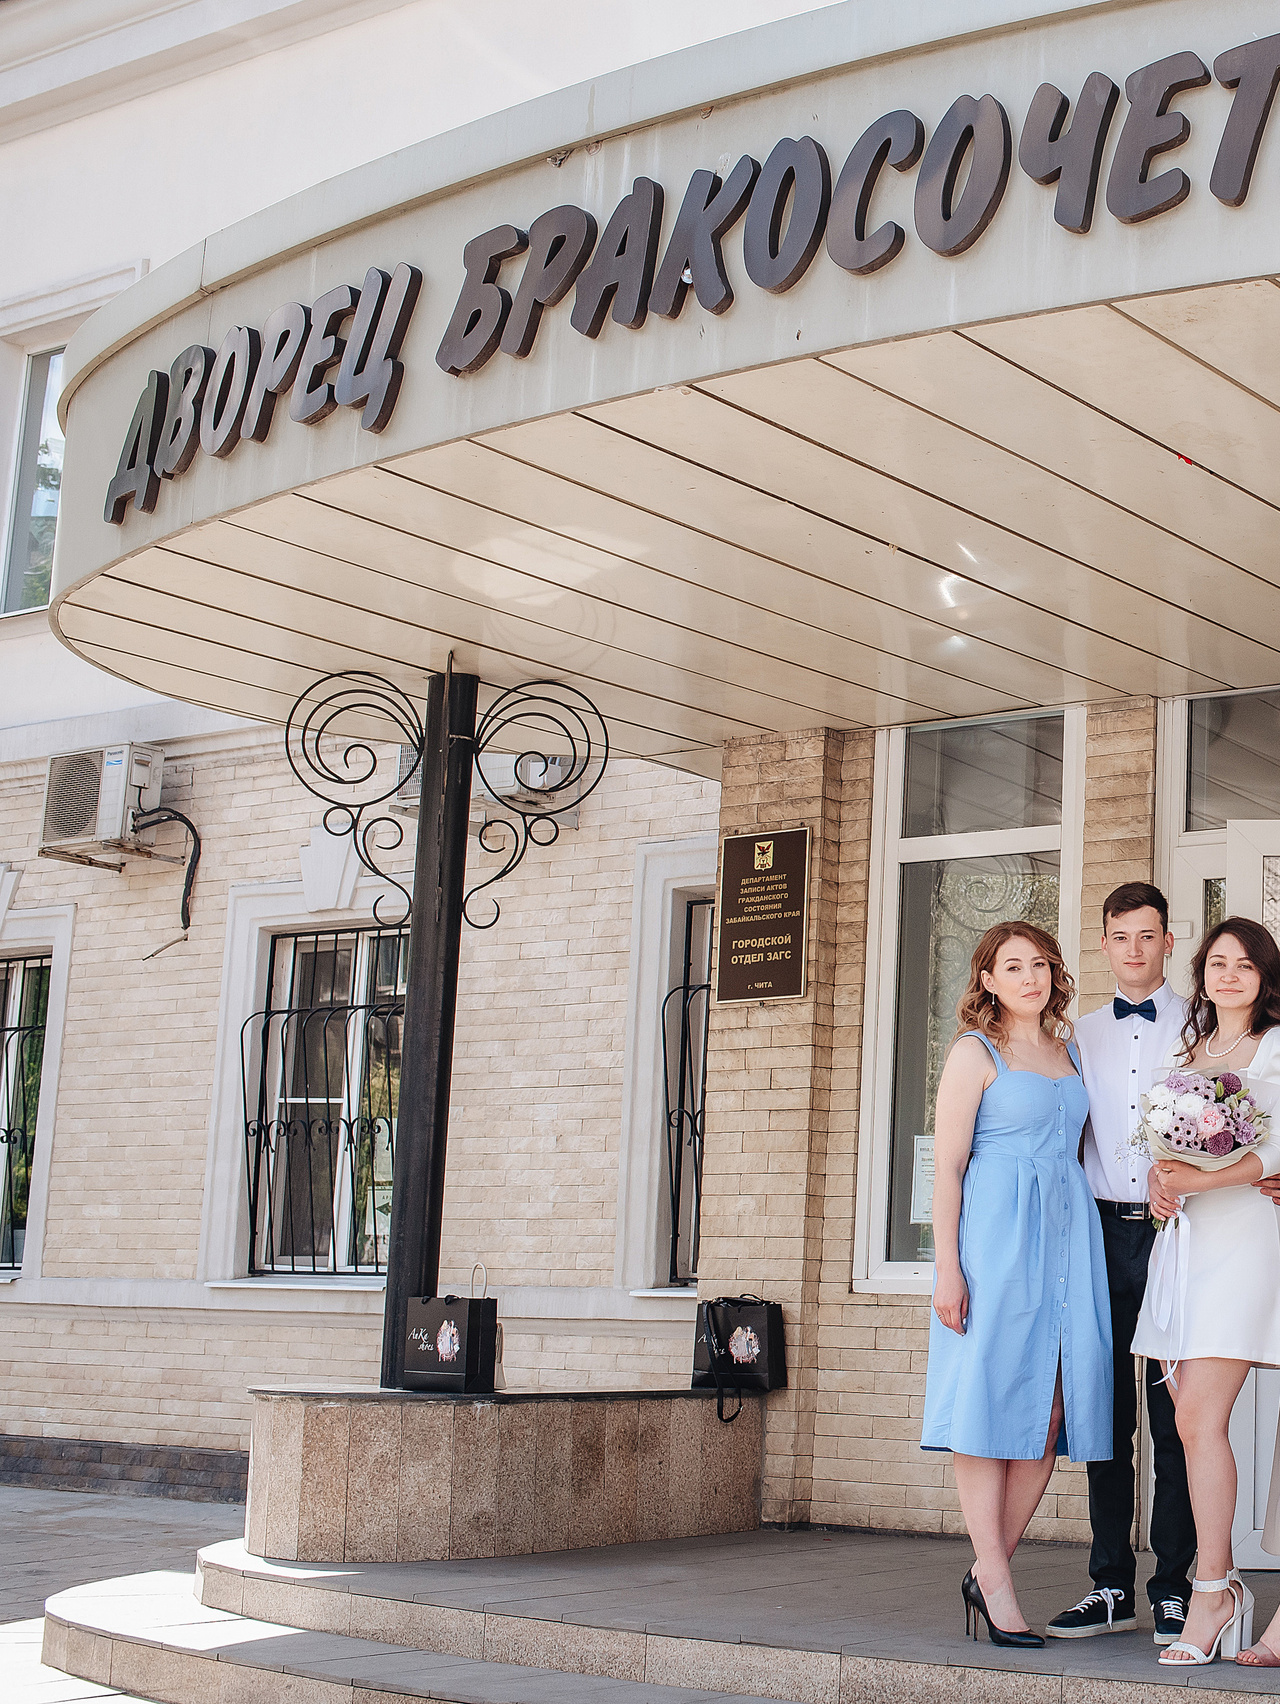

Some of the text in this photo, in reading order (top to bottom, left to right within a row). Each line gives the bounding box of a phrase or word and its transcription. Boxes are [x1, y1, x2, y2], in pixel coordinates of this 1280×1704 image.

[103, 261, 423, 526] ДВОРЕЦ
[741, 874, 787, 885] ДЕПАРТАМЕНТ
[739, 883, 788, 894] ЗАПИСИ АКТОВ
[738, 892, 789, 904] ГРАЖДАНСКОГО
[743, 902, 782, 913] СОСТОЯНИЯ
[725, 910, 801, 924] ЗАБАЙКАЛЬСКОГО КРАЯ
[732, 933, 791, 949] ГОРОДСКОЙ
[731, 950, 792, 965] ОТДЕЛ ЗАГС
[754, 981, 773, 989] ЧИТА
